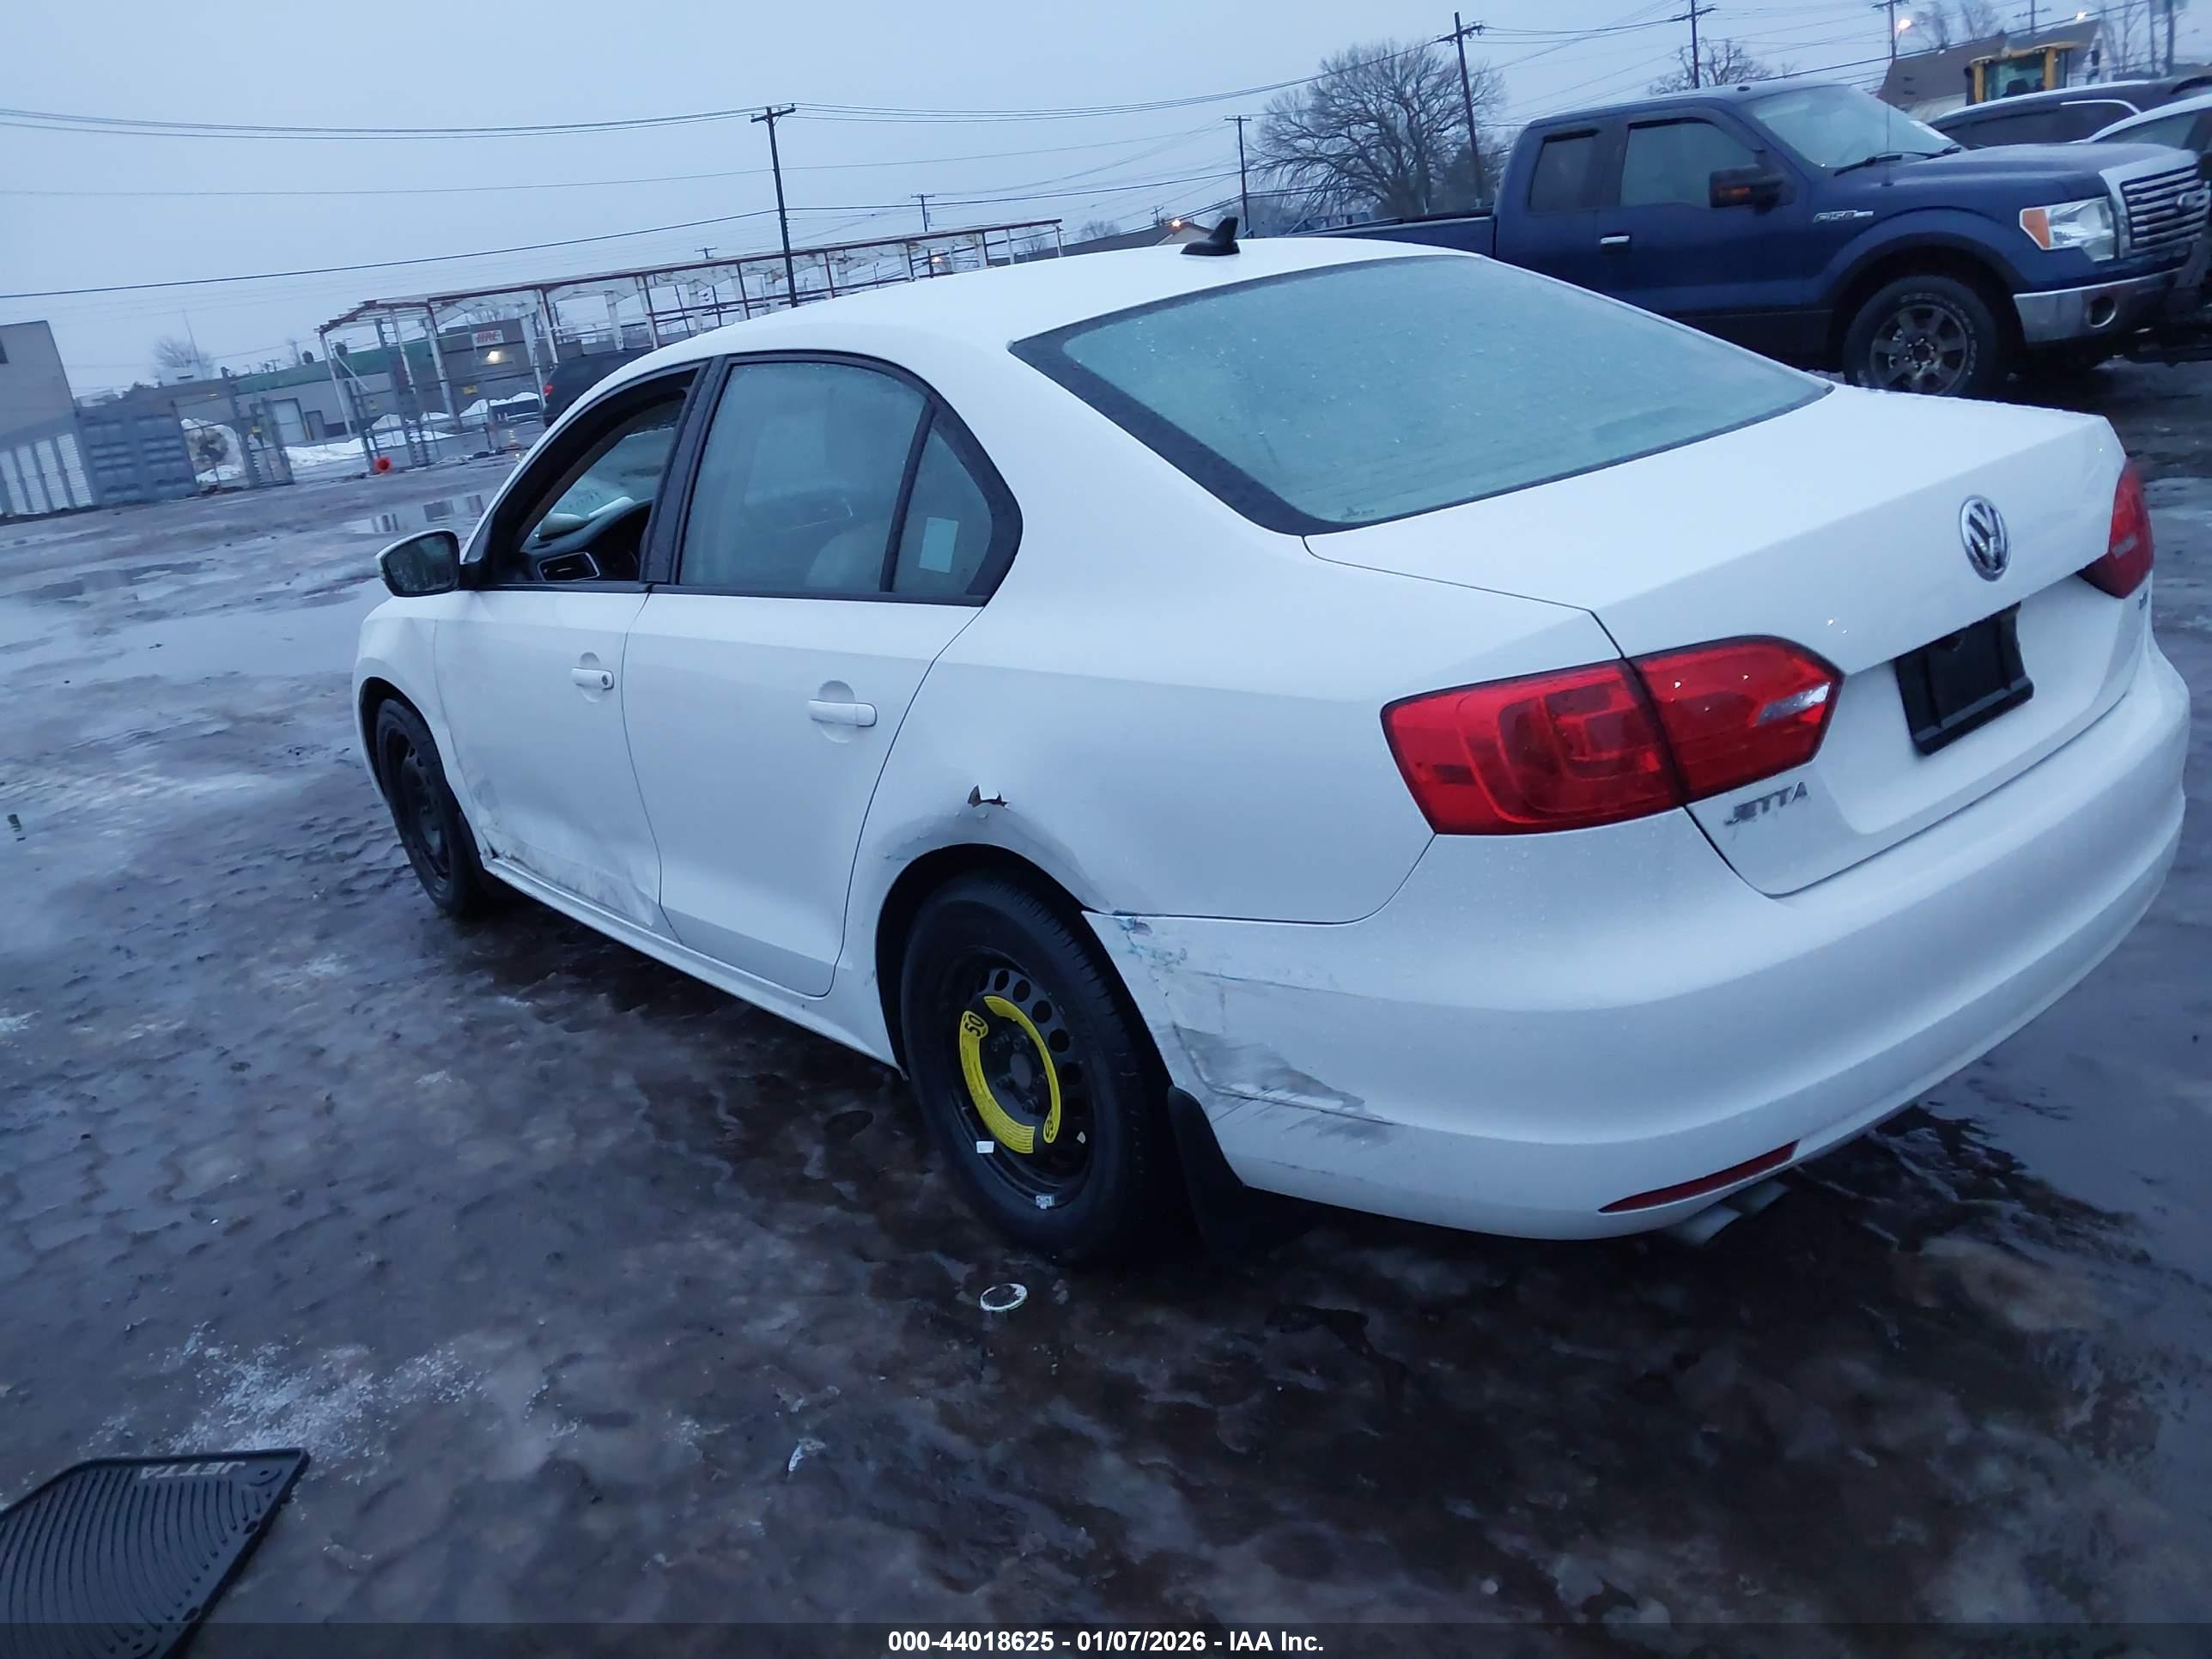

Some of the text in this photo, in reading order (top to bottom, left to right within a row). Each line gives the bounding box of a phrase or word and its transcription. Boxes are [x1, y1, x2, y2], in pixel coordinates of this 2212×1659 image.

[1723, 782, 1808, 826] JETTA
[964, 1014, 981, 1036] 50
[140, 1462, 246, 1479] JETTA
